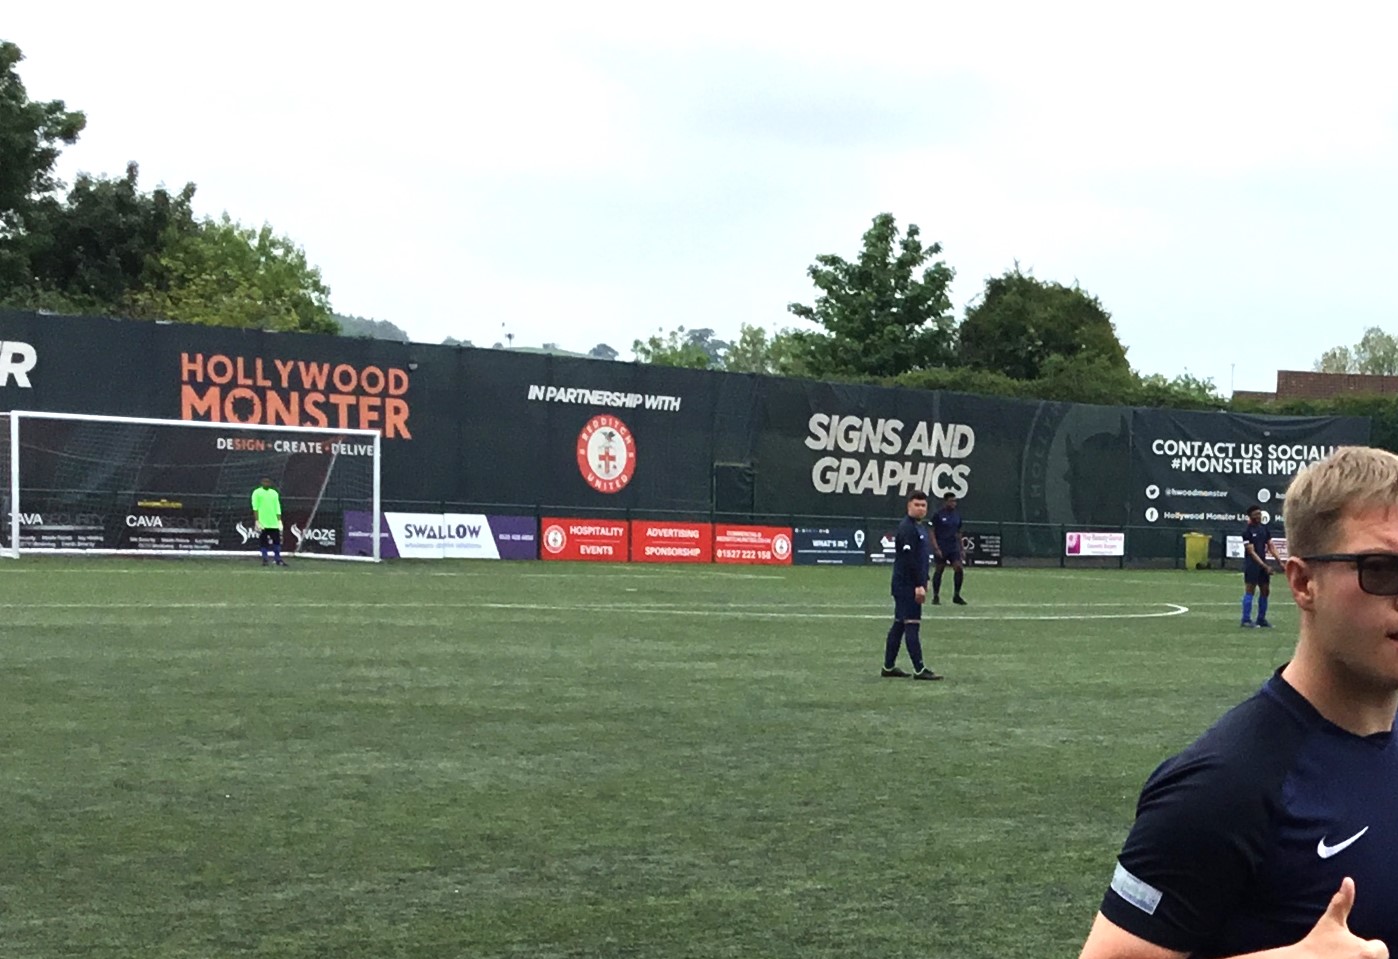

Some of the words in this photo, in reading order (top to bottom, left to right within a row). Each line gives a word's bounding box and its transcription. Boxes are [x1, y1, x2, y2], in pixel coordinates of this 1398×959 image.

[181, 352, 409, 396] HOLLYWOOD
[528, 385, 545, 400] IN
[546, 387, 642, 408] PARTNERSHIP
[645, 394, 681, 411] WITH
[181, 384, 412, 439] MONSTER
[582, 417, 632, 445] REDDITCH
[805, 413, 904, 455] SIGNS
[904, 421, 975, 458] AND
[217, 437, 264, 452] DESIGN
[274, 440, 322, 454] CREATE
[331, 442, 380, 457] DELIVE
[1152, 439, 1235, 458] CONTACT
[1240, 444, 1263, 459] US
[1268, 444, 1335, 461] SOCIAL
[1171, 457, 1262, 475] #MONSTER
[1267, 459, 1308, 475] IMPA
[587, 473, 628, 491] UNITED
[812, 456, 971, 499] GRAPHICS
[126, 515, 162, 527] CAVA
[1164, 511, 1204, 521] Hollywood
[1206, 512, 1235, 521] Monster
[404, 523, 482, 540] SWALLOW
[570, 526, 624, 537] HOSPITALITY
[646, 528, 699, 539] ADVERTISING
[580, 545, 613, 556] EVENTS
[645, 546, 701, 557] SPONSORSHIP
